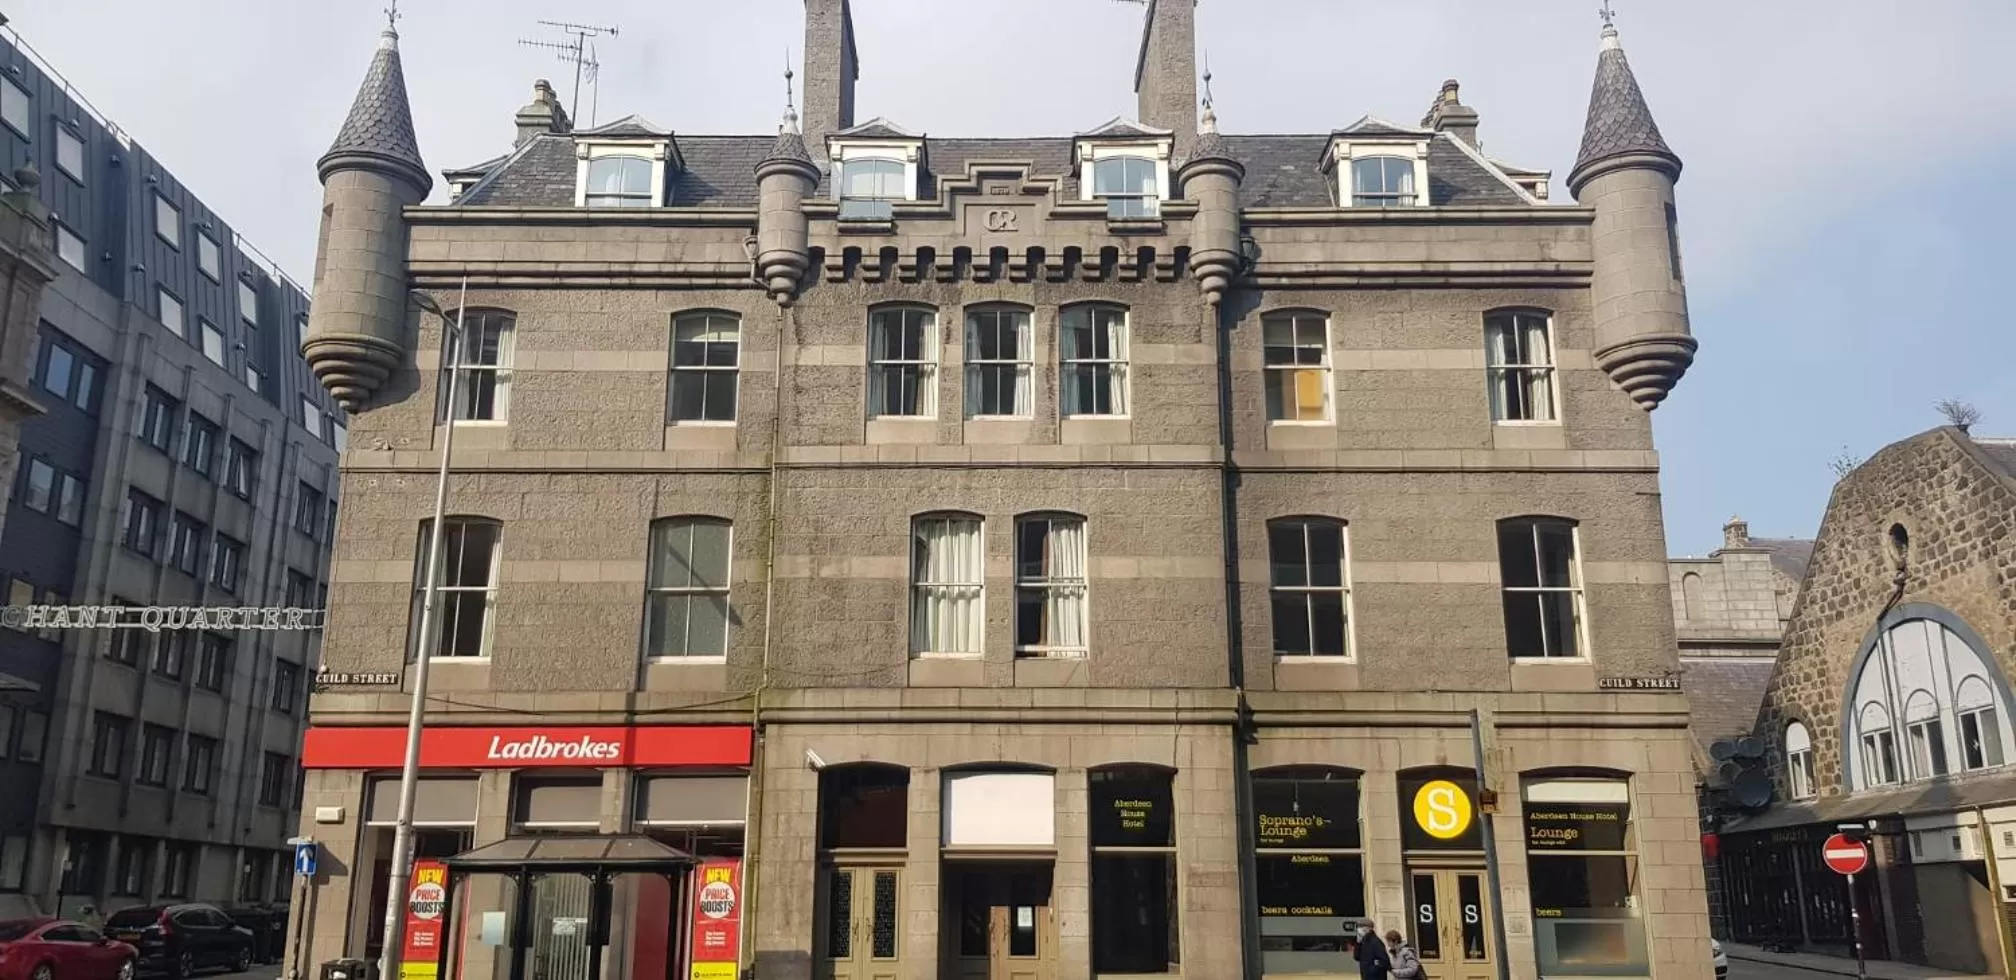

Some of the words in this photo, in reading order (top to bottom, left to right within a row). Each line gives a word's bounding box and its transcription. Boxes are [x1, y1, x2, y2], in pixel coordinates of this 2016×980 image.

[141, 605, 304, 632] QUARTER
[315, 673, 348, 684] GUILD
[352, 673, 397, 684] STREET
[1599, 678, 1632, 688] GUILD
[1636, 678, 1679, 688] STREET
[487, 735, 620, 759] Ladbrokes
[1113, 799, 1153, 808] Aberdeen
[1427, 787, 1458, 831] S
[1530, 812, 1568, 820] Aberdeen
[1260, 824, 1307, 838] Lounge
[1530, 826, 1579, 840] Lounge
[1291, 854, 1330, 863] Aberdeen
[417, 868, 444, 885] NEW
[706, 867, 731, 883] NEW
[415, 888, 441, 901] PRICE
[705, 887, 730, 900] PRICE
[410, 901, 445, 913] BOOSTS
[701, 900, 734, 913] BOOSTS
[1261, 905, 1287, 914] beers
[1291, 905, 1333, 915] cocktails
[1419, 904, 1434, 923] S
[1464, 904, 1479, 923] S
